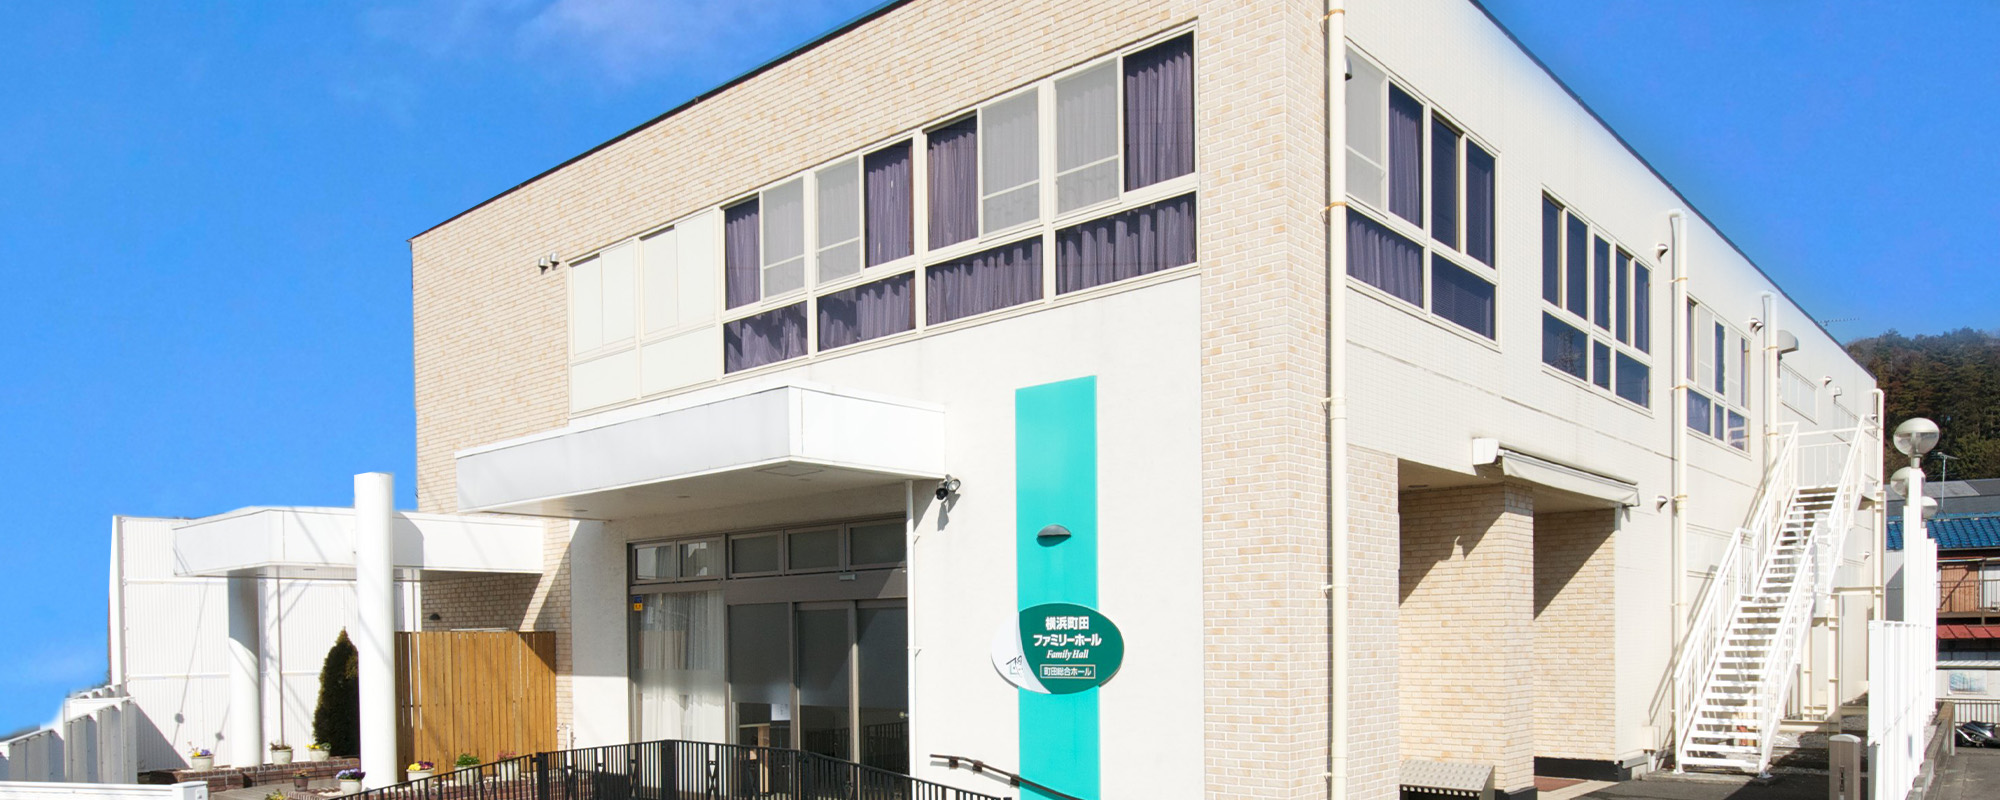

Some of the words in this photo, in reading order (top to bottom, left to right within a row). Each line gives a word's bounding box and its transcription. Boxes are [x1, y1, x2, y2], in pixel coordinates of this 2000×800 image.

[1045, 616, 1090, 631] 横浜町田
[1033, 633, 1102, 647] ファミリーホール
[1046, 649, 1072, 661] Family
[1072, 649, 1089, 659] Hall
[1043, 666, 1092, 676] 町田総合ホール
